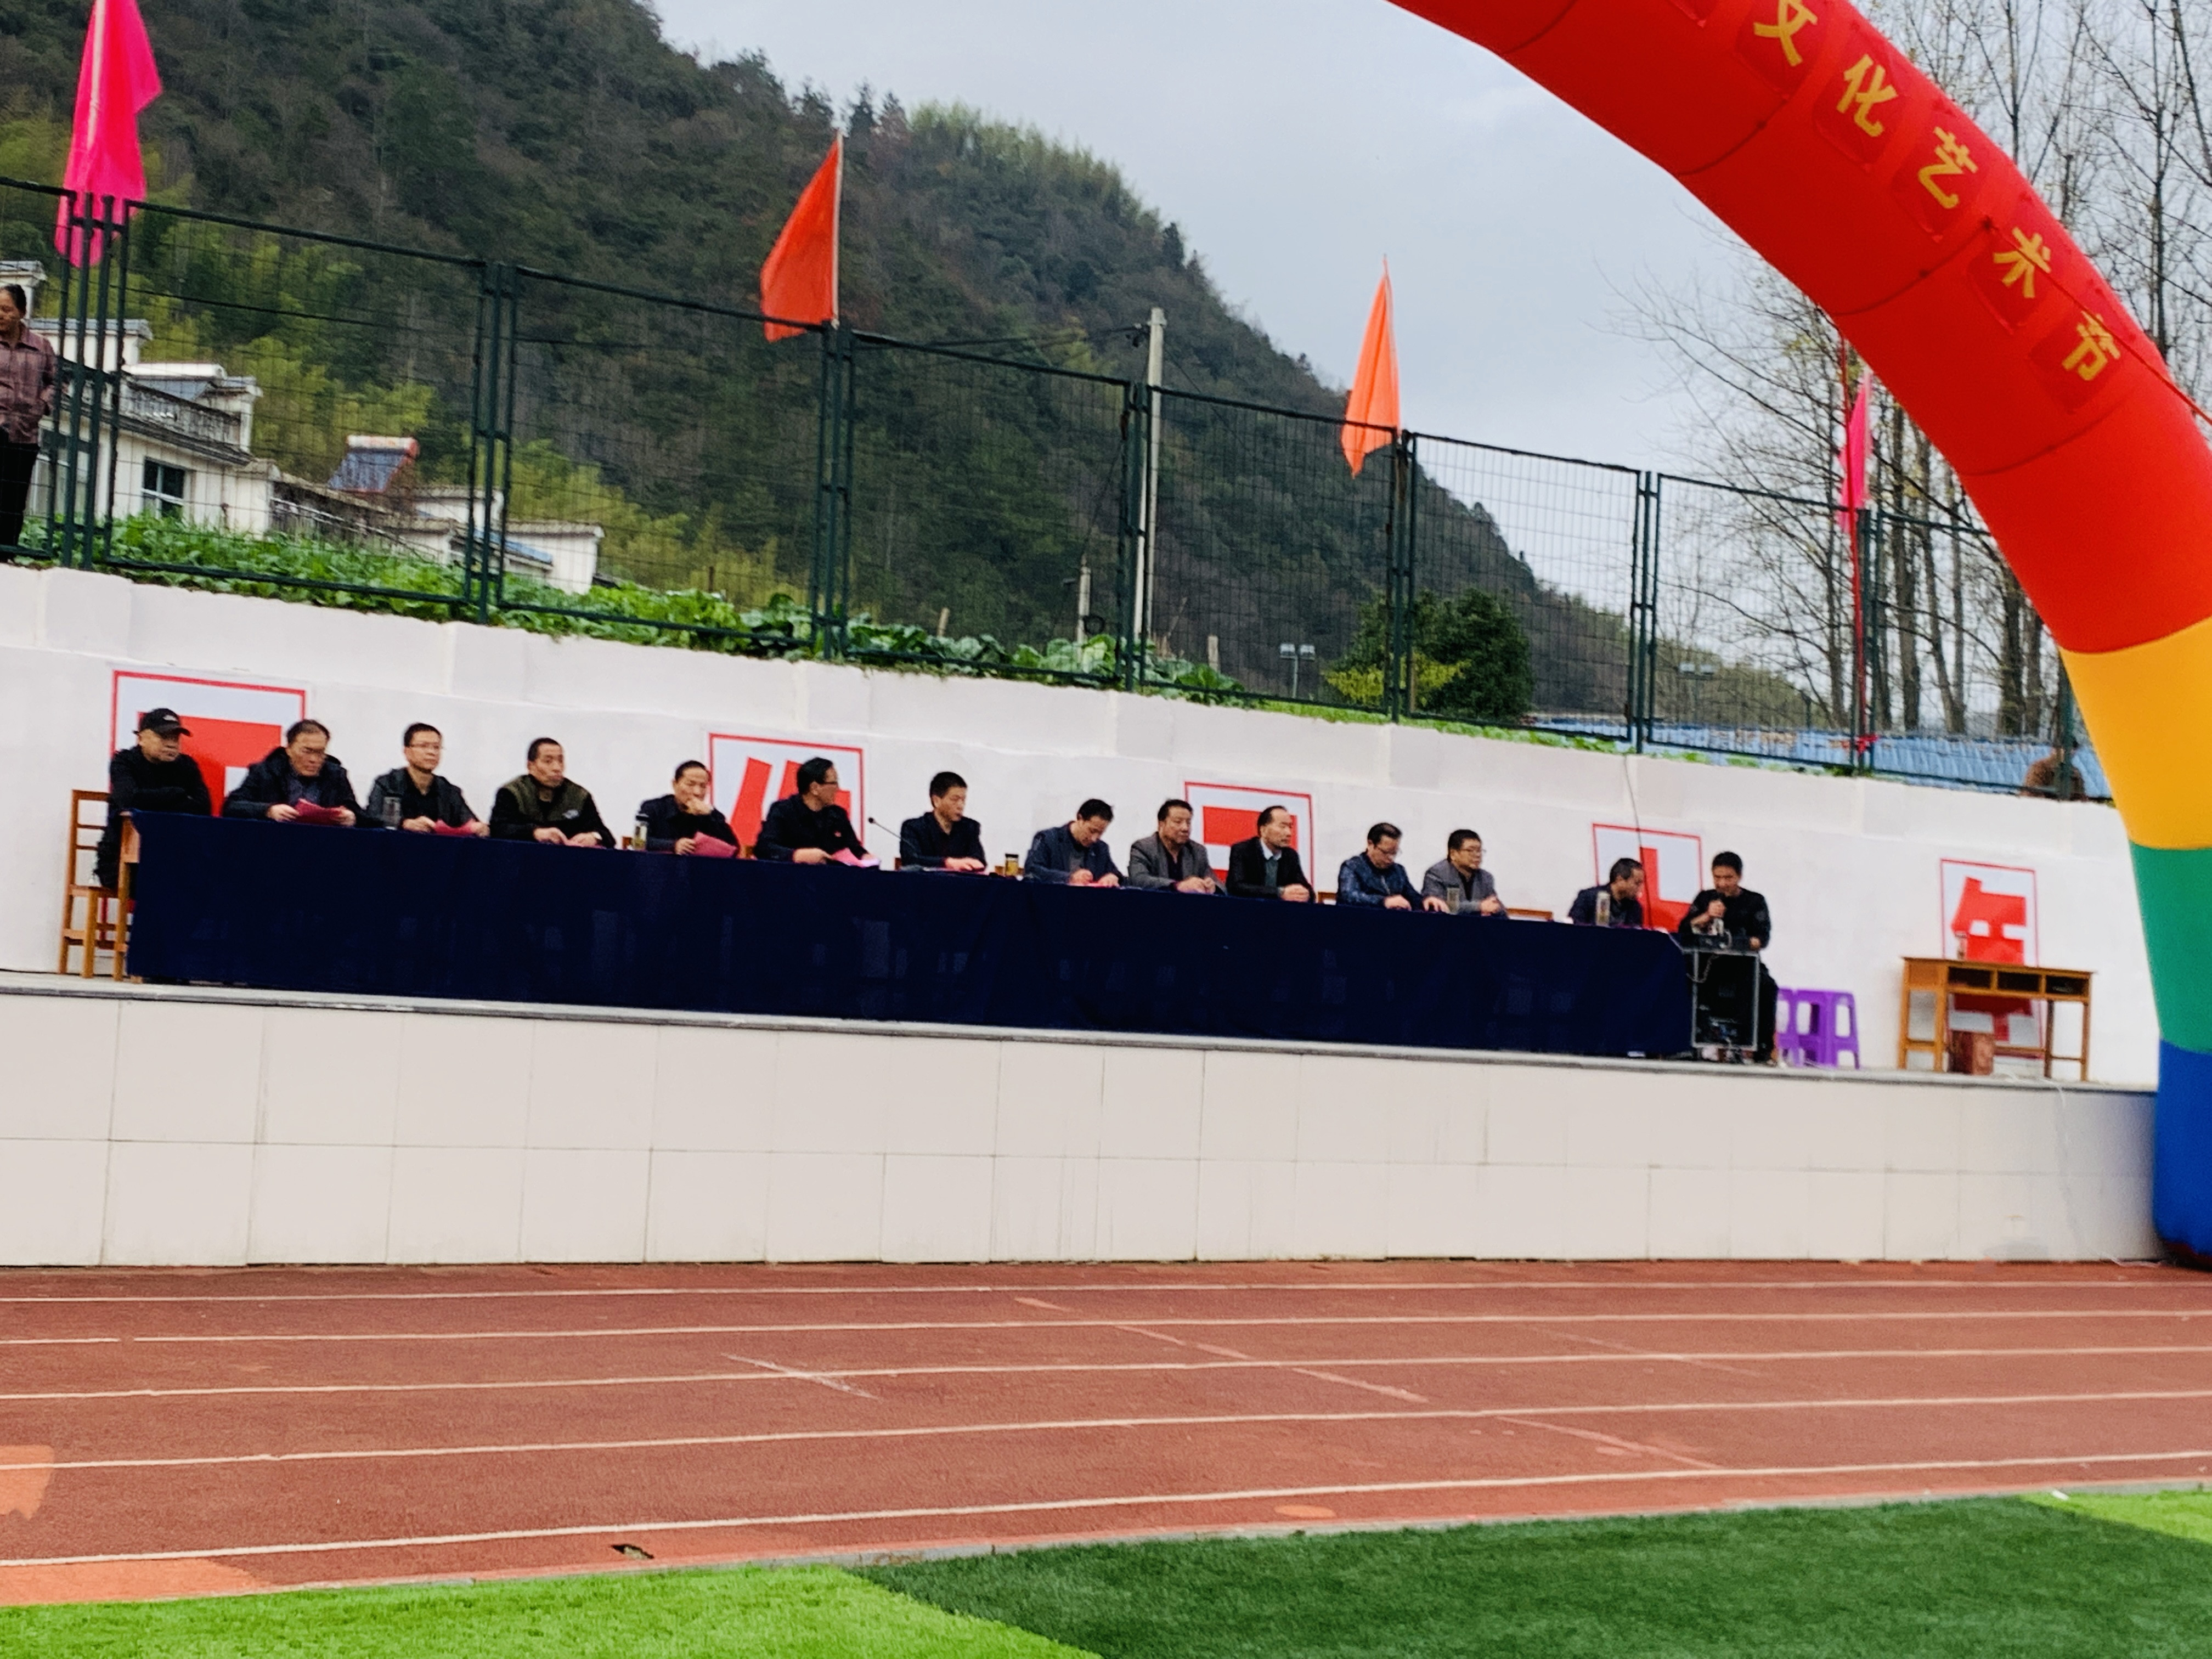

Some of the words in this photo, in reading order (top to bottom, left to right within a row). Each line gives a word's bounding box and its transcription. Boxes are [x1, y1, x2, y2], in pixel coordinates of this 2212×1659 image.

[1753, 0, 2121, 381] 文化艺术节
